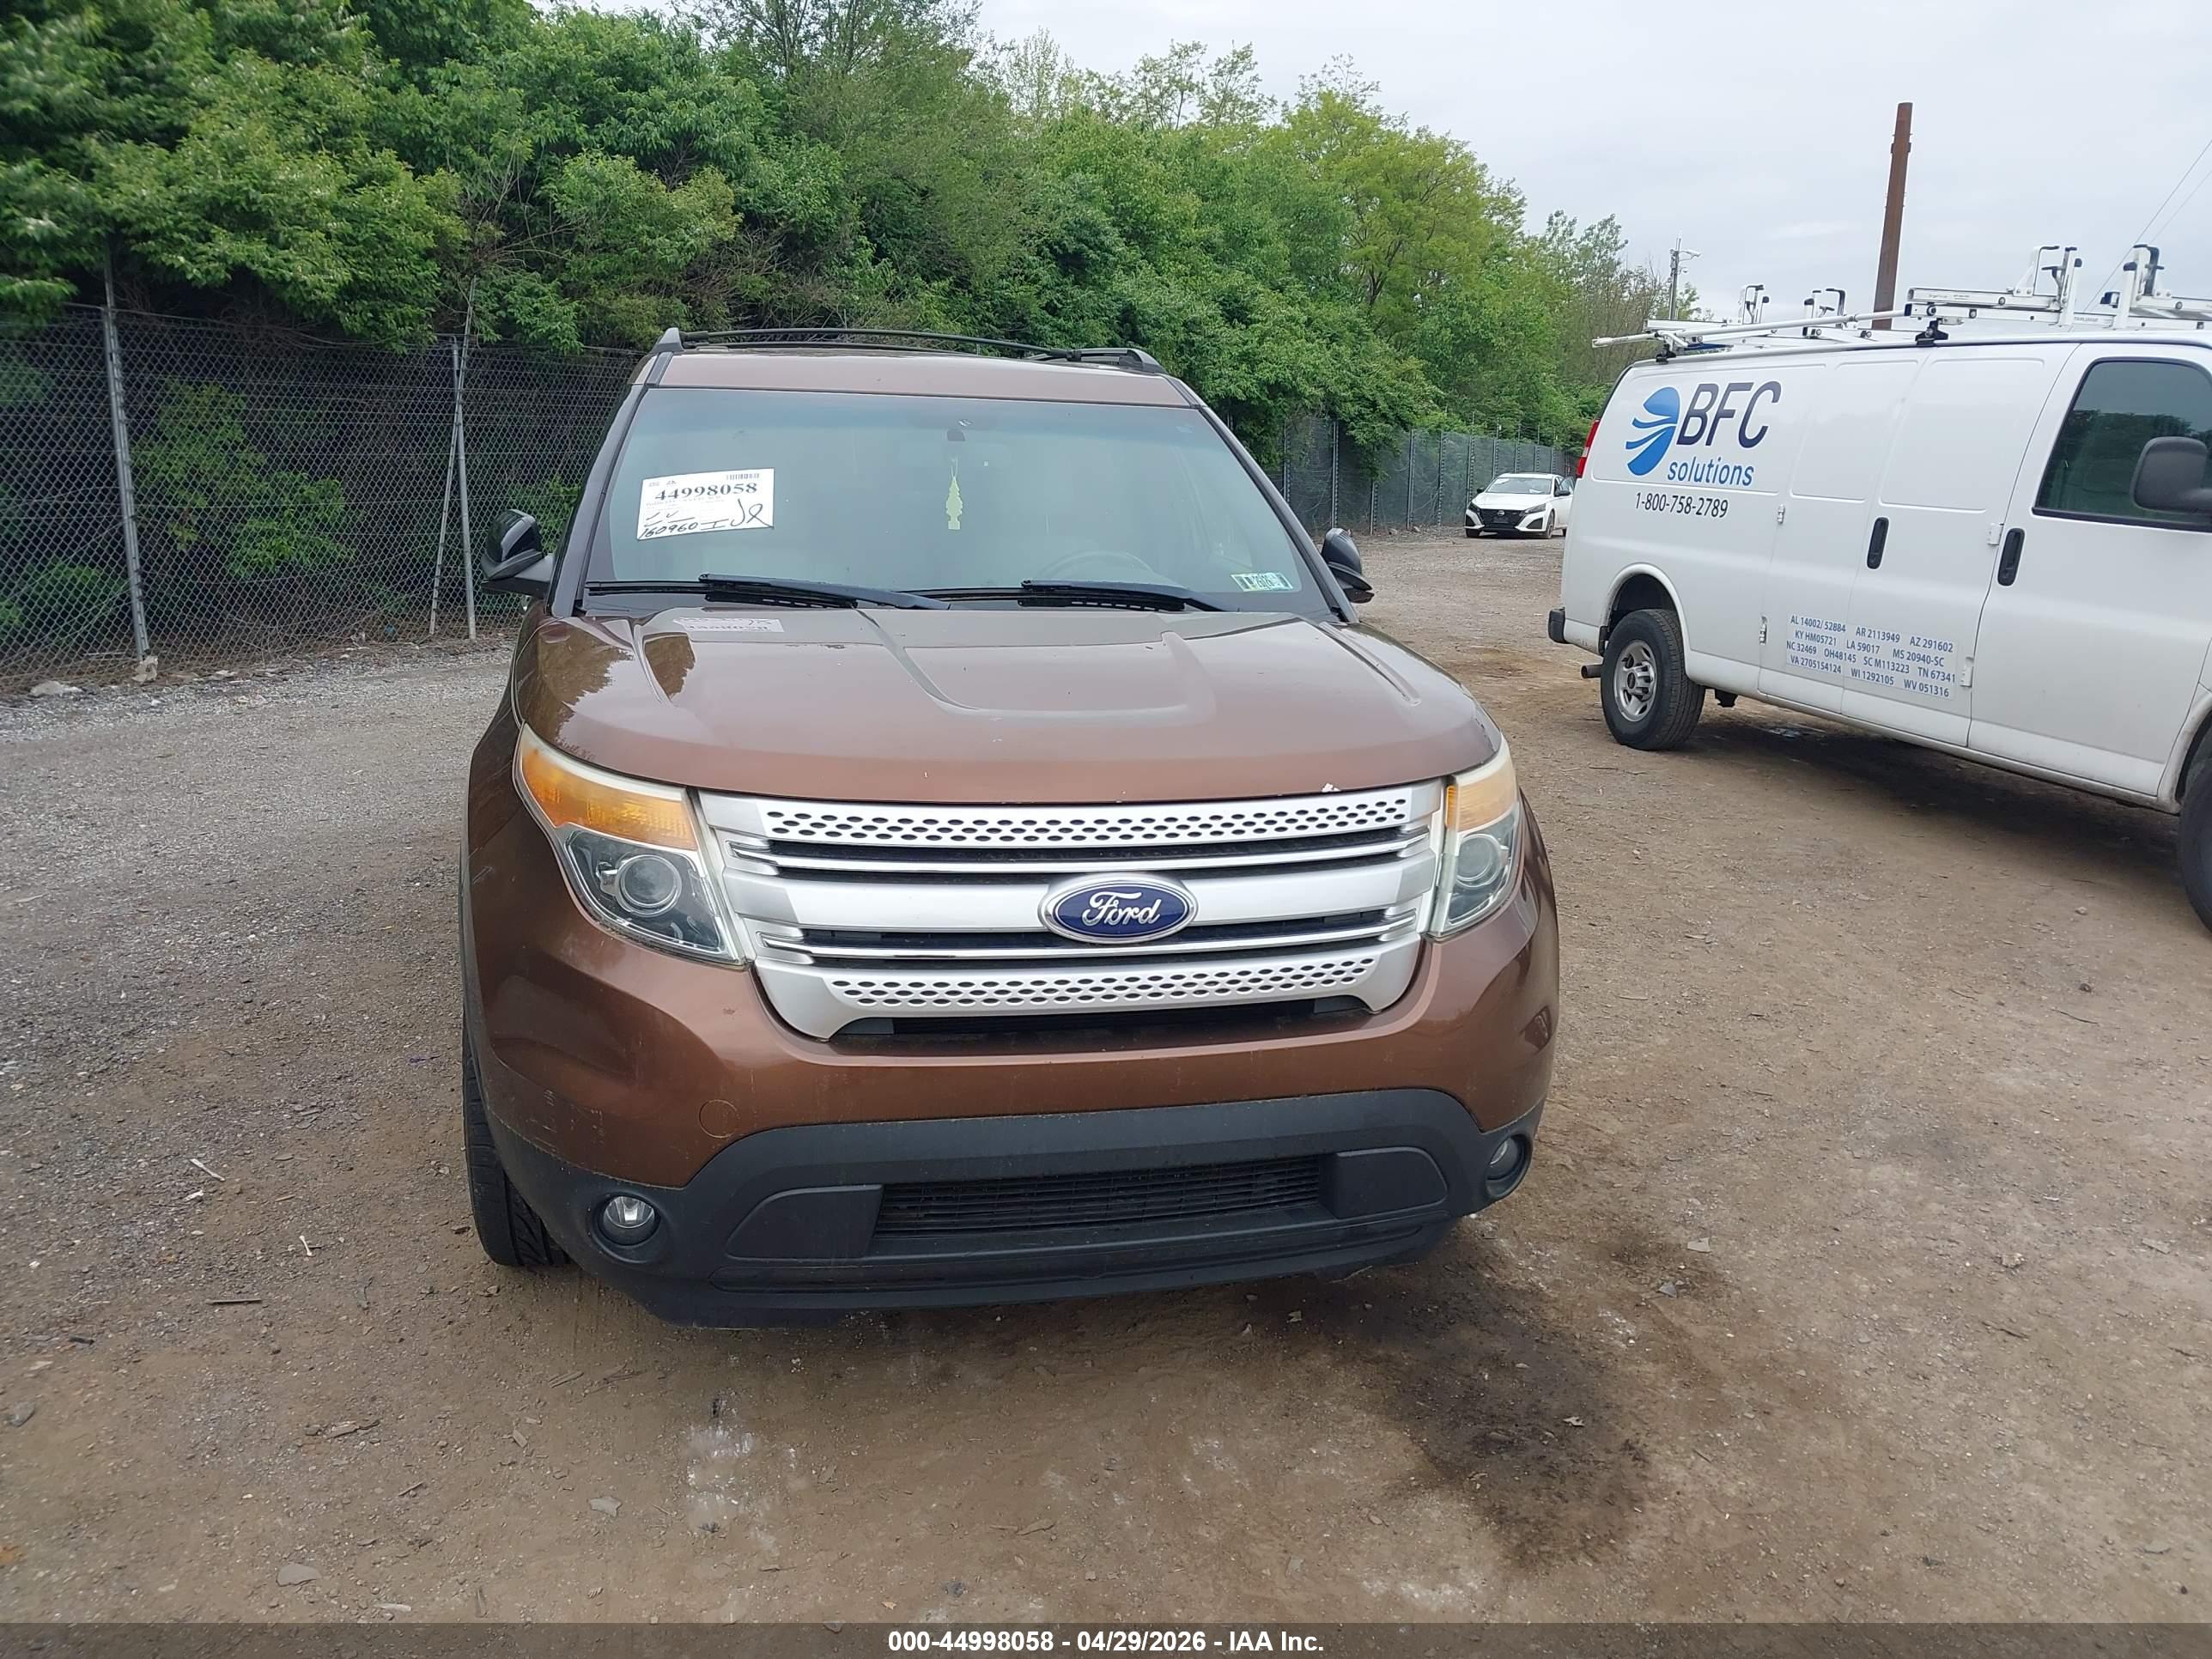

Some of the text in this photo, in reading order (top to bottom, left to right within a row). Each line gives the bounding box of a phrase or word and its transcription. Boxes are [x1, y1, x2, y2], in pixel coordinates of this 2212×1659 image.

[1676, 381, 1782, 448] BFC
[1668, 457, 1753, 486] solutions
[655, 483, 757, 501] 44998058
[1636, 492, 1729, 518] 1-800-758-2789
[1790, 615, 1799, 624] AL
[1856, 626, 1866, 637] AR
[1868, 629, 1900, 643] 2113949
[1910, 636, 1921, 647] AZ
[1923, 639, 1954, 653] 291602
[1796, 629, 1944, 667] KY HM05721 LA 59017 MS 20940-SC
[1787, 641, 1795, 650] NC
[1796, 643, 1817, 654] 32469
[1863, 656, 1873, 666] SC
[1875, 659, 1910, 673] M113223
[1917, 666, 1929, 678] TN
[1930, 670, 1955, 684] 67341
[1790, 654, 1949, 697] VA 2705154124 WI 1292105 WV 051316
[1082, 891, 1162, 927] Ford
